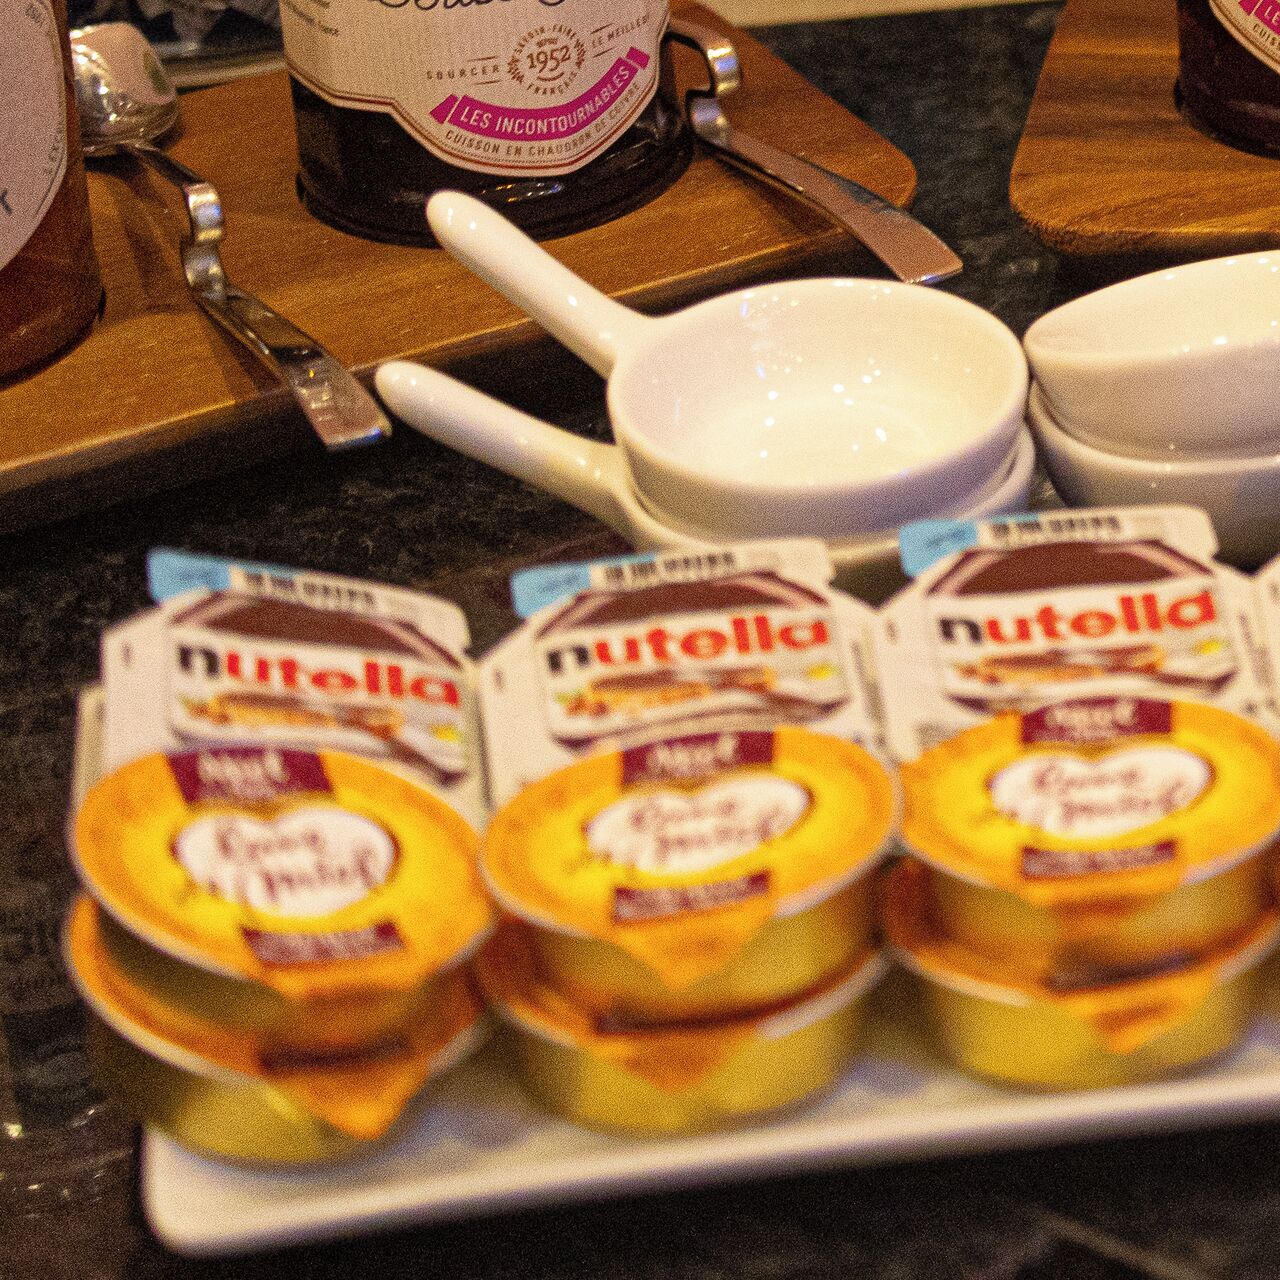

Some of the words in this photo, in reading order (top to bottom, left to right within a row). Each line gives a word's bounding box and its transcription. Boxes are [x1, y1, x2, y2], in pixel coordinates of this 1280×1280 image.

[425, 63, 501, 82] SOURCER
[526, 44, 572, 74] 1952
[459, 105, 490, 130] LES
[494, 66, 631, 136] INCONTOURNABLES
[444, 128, 501, 156] CUISSON
[506, 142, 523, 157] EN
[527, 130, 593, 157] CHAUDRON
[594, 118, 608, 134] DE
[545, 611, 830, 677] nutella
[937, 589, 1218, 646] nutella
[175, 643, 461, 709] nutella
